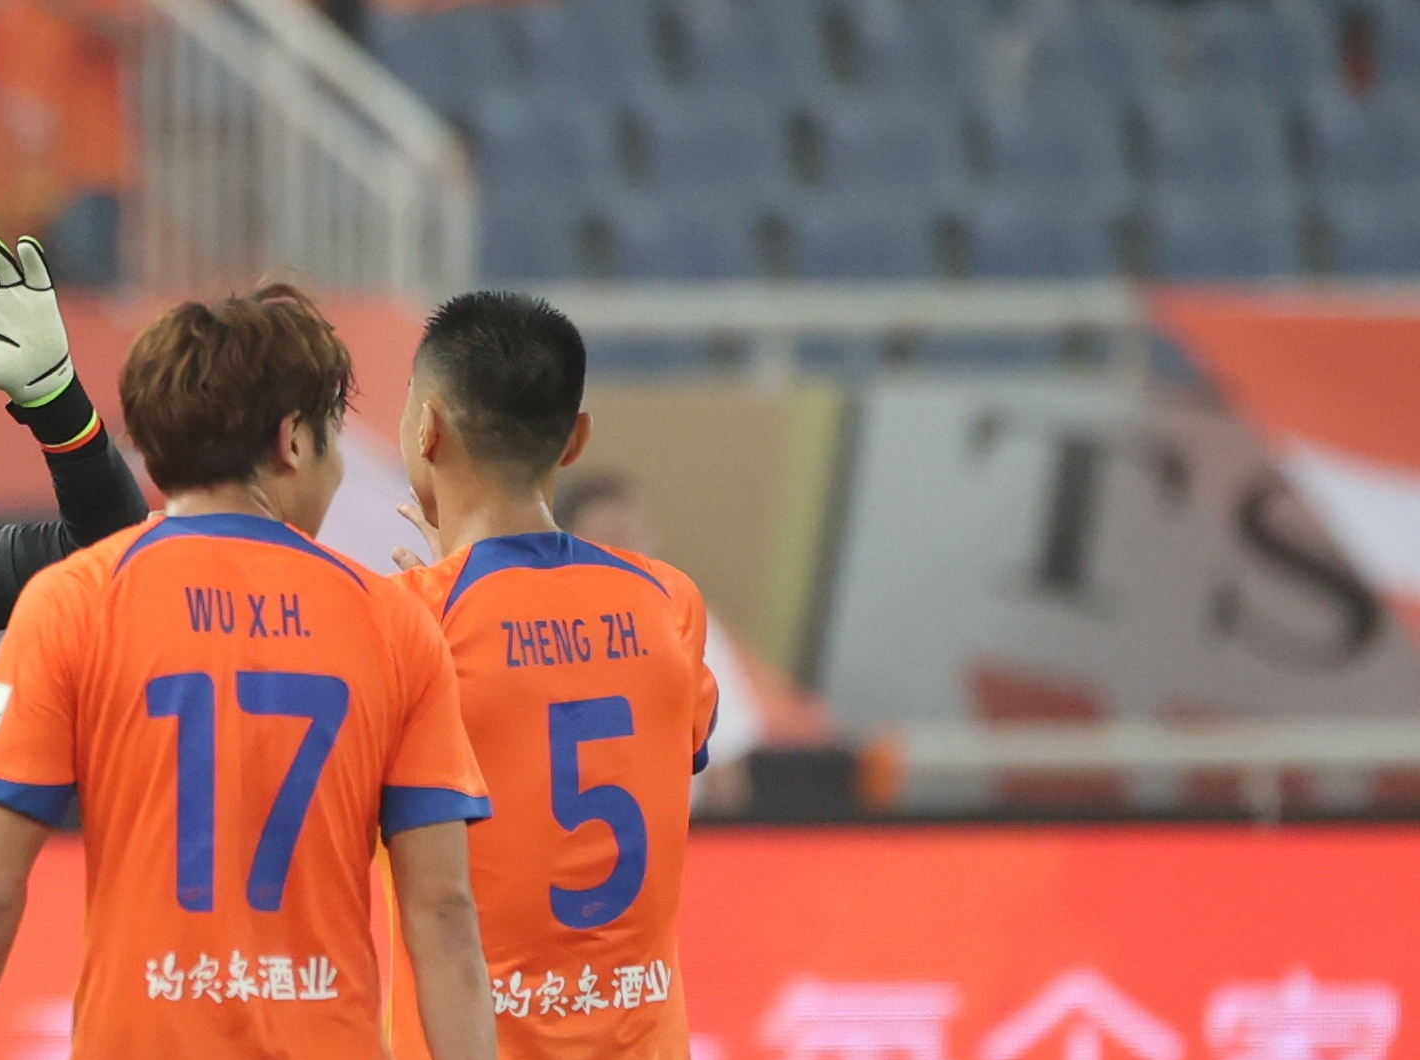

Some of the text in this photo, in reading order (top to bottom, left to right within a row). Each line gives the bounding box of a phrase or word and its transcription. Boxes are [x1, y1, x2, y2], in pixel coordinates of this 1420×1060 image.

[184, 586, 311, 638] WU X.H.
[500, 611, 649, 668] ZHENG ZH.
[145, 671, 350, 913] 17
[548, 695, 648, 930] 5
